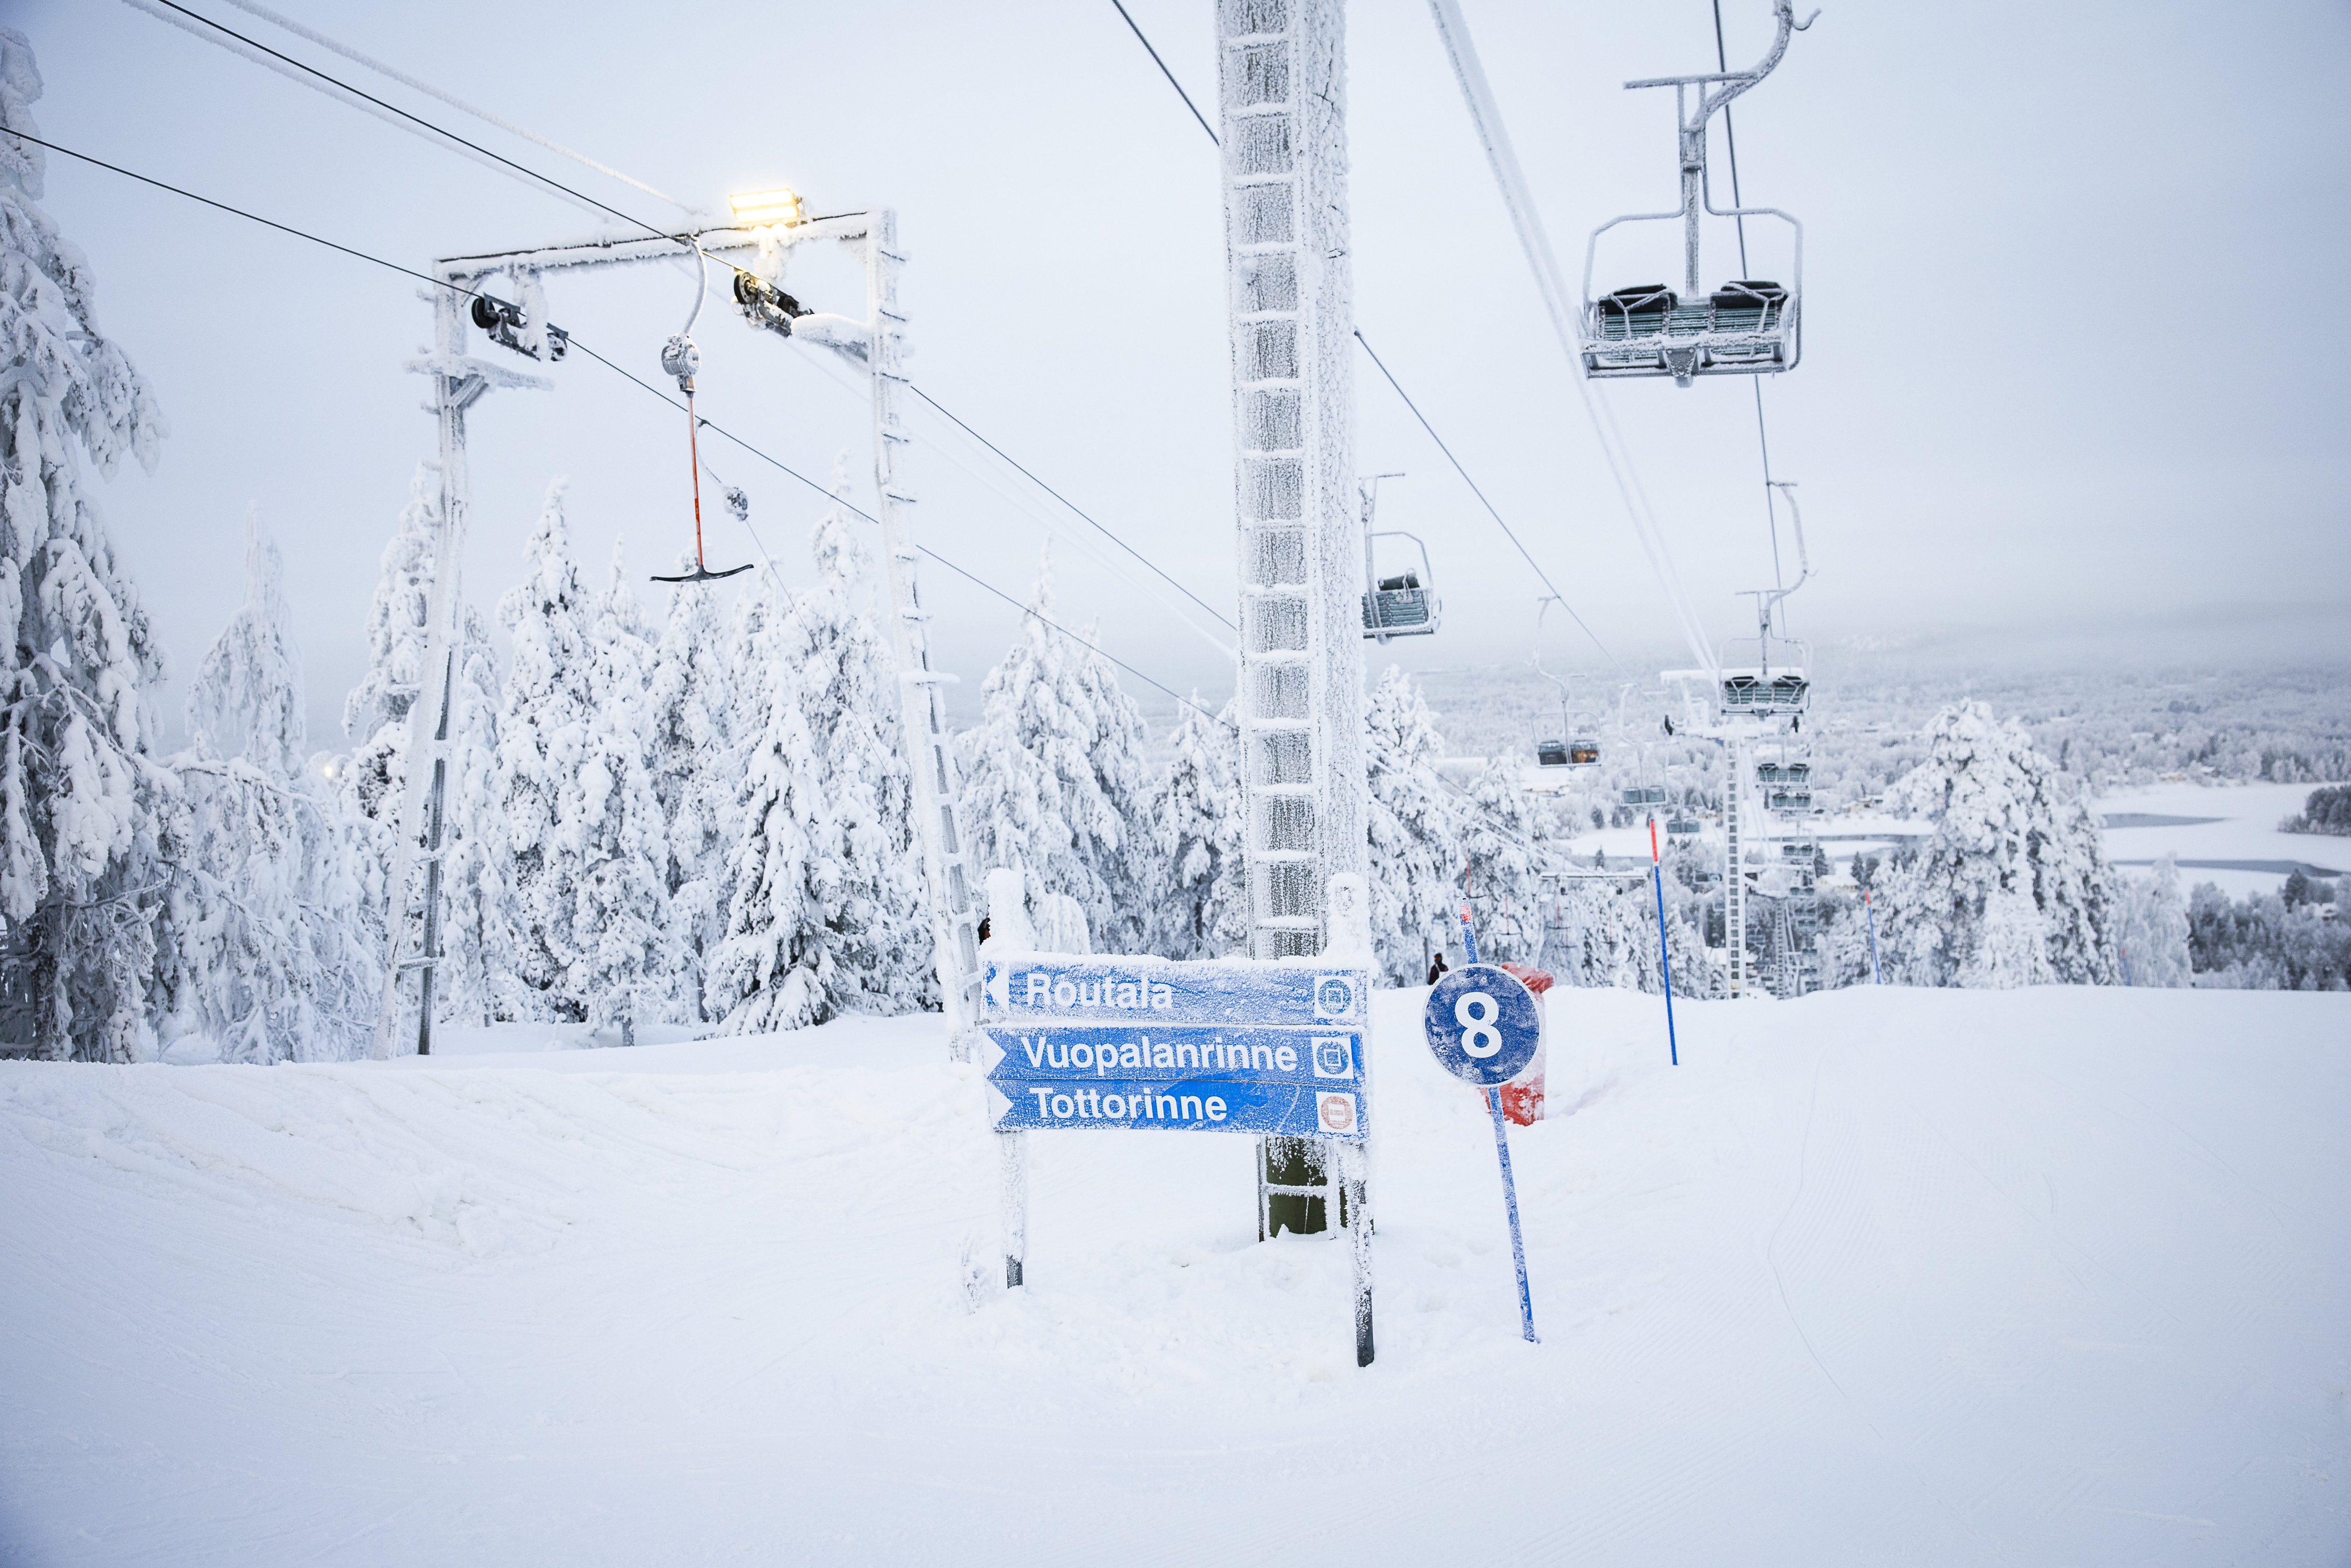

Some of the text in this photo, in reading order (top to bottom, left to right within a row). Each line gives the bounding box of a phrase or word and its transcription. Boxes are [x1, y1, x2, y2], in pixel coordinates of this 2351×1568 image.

[1027, 973, 1172, 1009] Routala
[1454, 992, 1502, 1058] 8
[1020, 1036, 1297, 1076] Vuopalanrinne
[1029, 1087, 1227, 1121] Tottorinne
